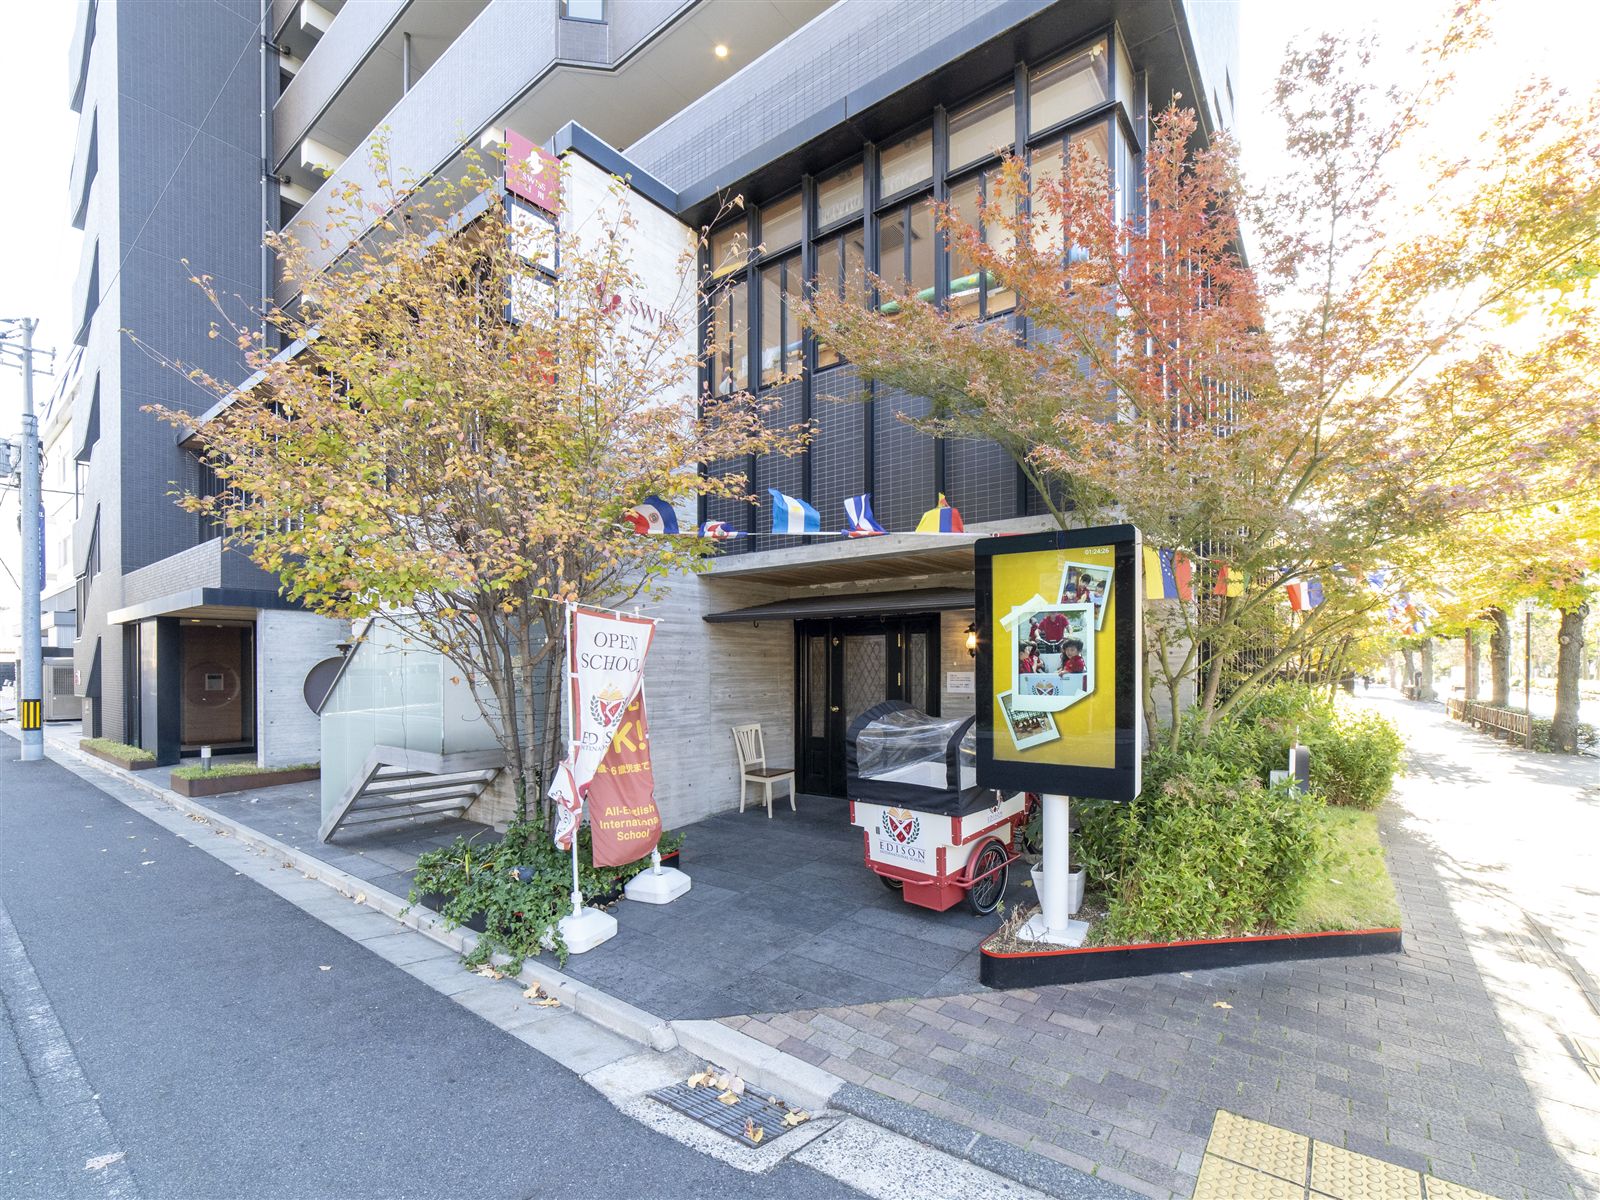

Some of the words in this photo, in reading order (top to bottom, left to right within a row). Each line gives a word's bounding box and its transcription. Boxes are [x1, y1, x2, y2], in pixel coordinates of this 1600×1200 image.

[1084, 547, 1110, 555] 01:24:26
[594, 631, 638, 651] OPEN
[605, 803, 655, 817] All-Eglish
[617, 828, 650, 841] School
[879, 841, 925, 860] EDISON
